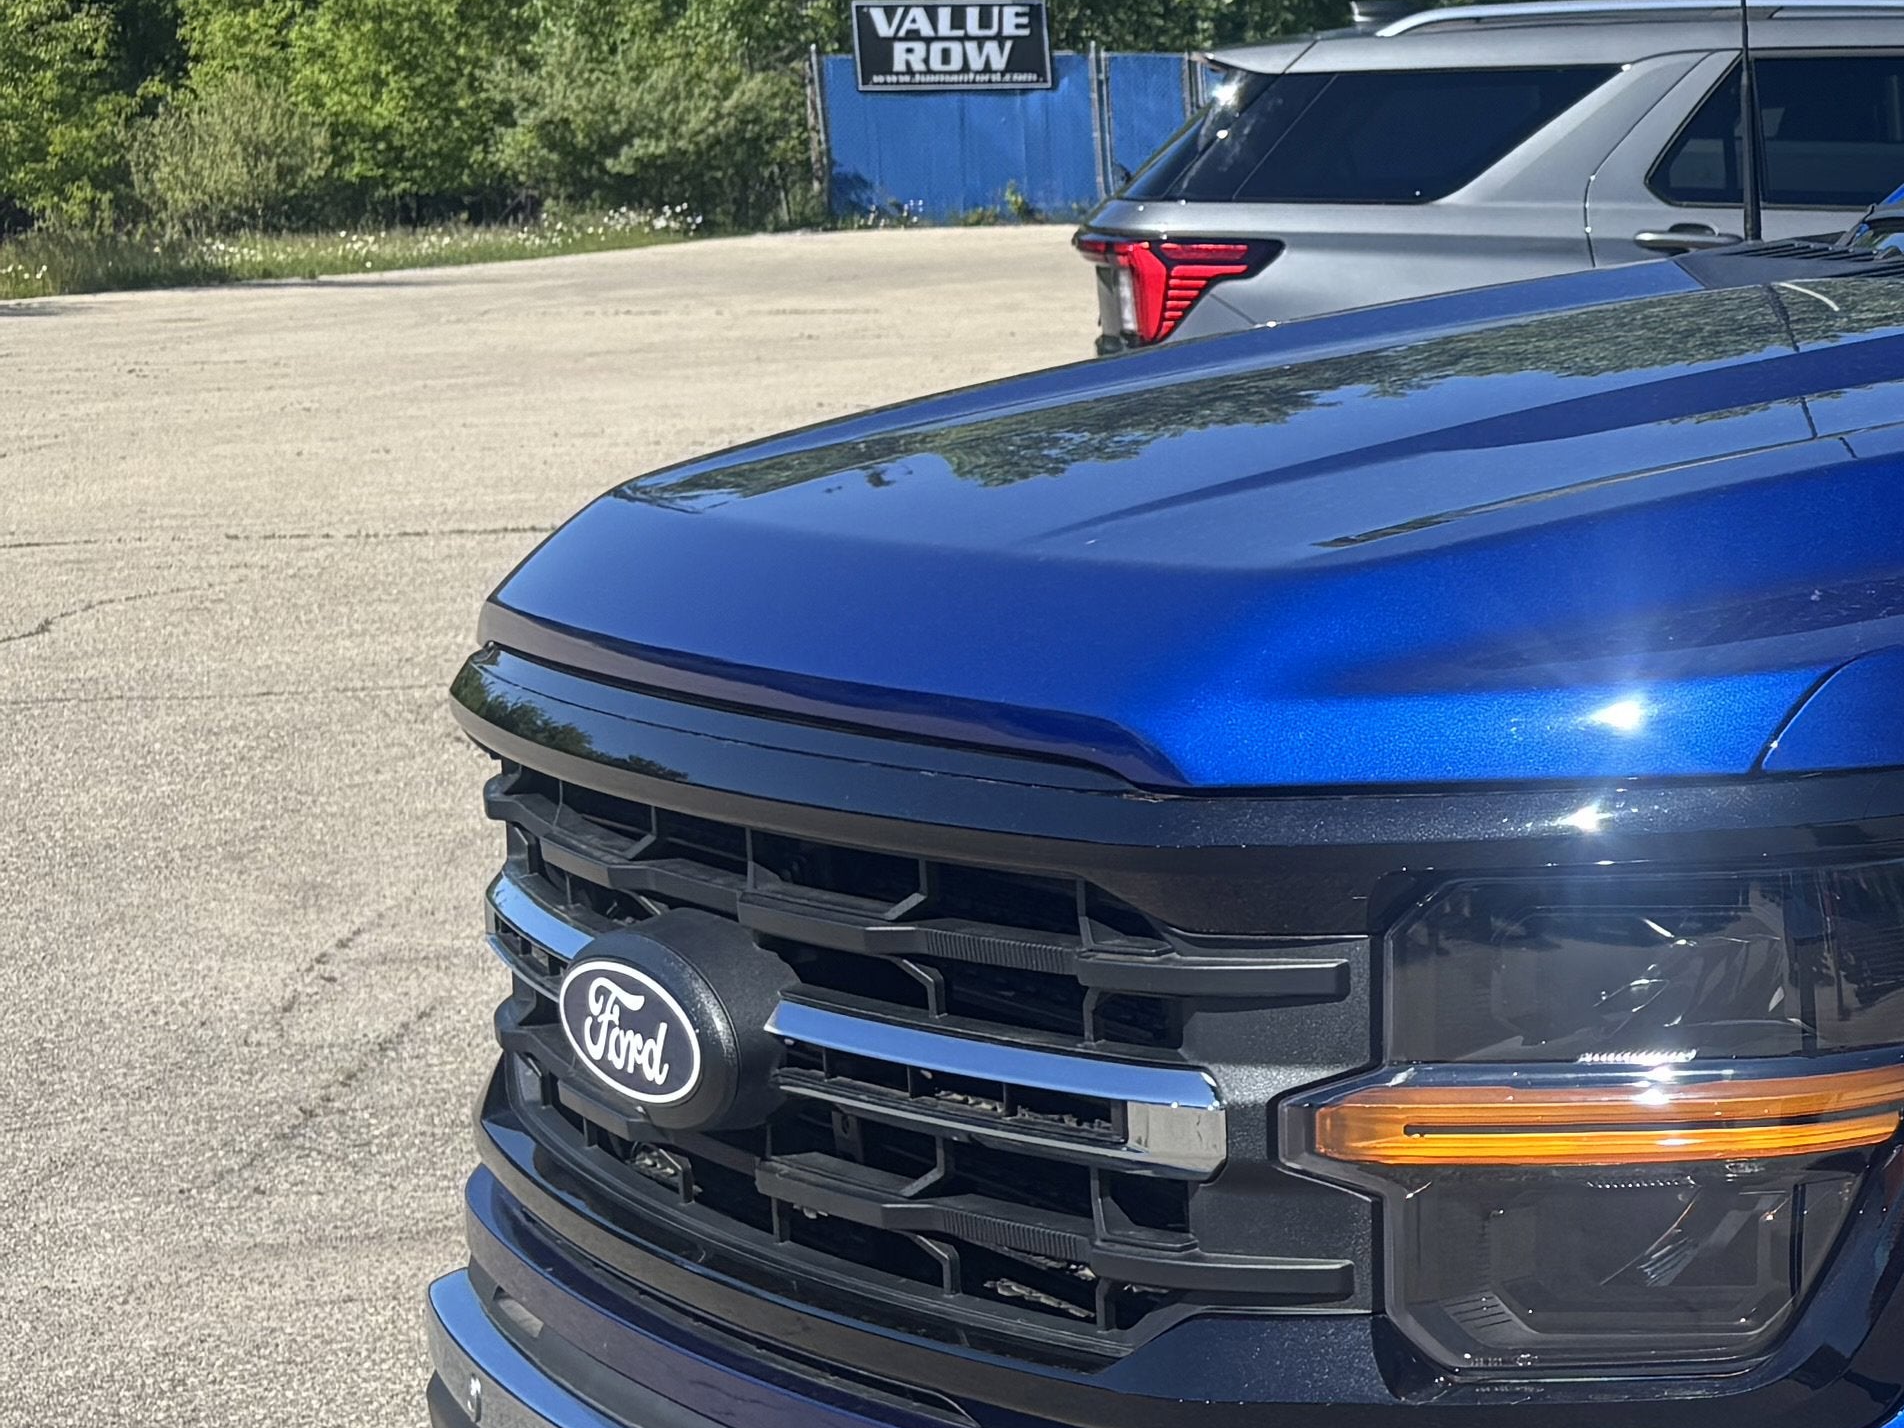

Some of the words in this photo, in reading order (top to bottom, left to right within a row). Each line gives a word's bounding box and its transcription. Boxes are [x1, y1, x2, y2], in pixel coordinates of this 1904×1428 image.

[868, 5, 1031, 38] VALUE
[892, 39, 1013, 72] ROW
[584, 976, 669, 1085] Ford
